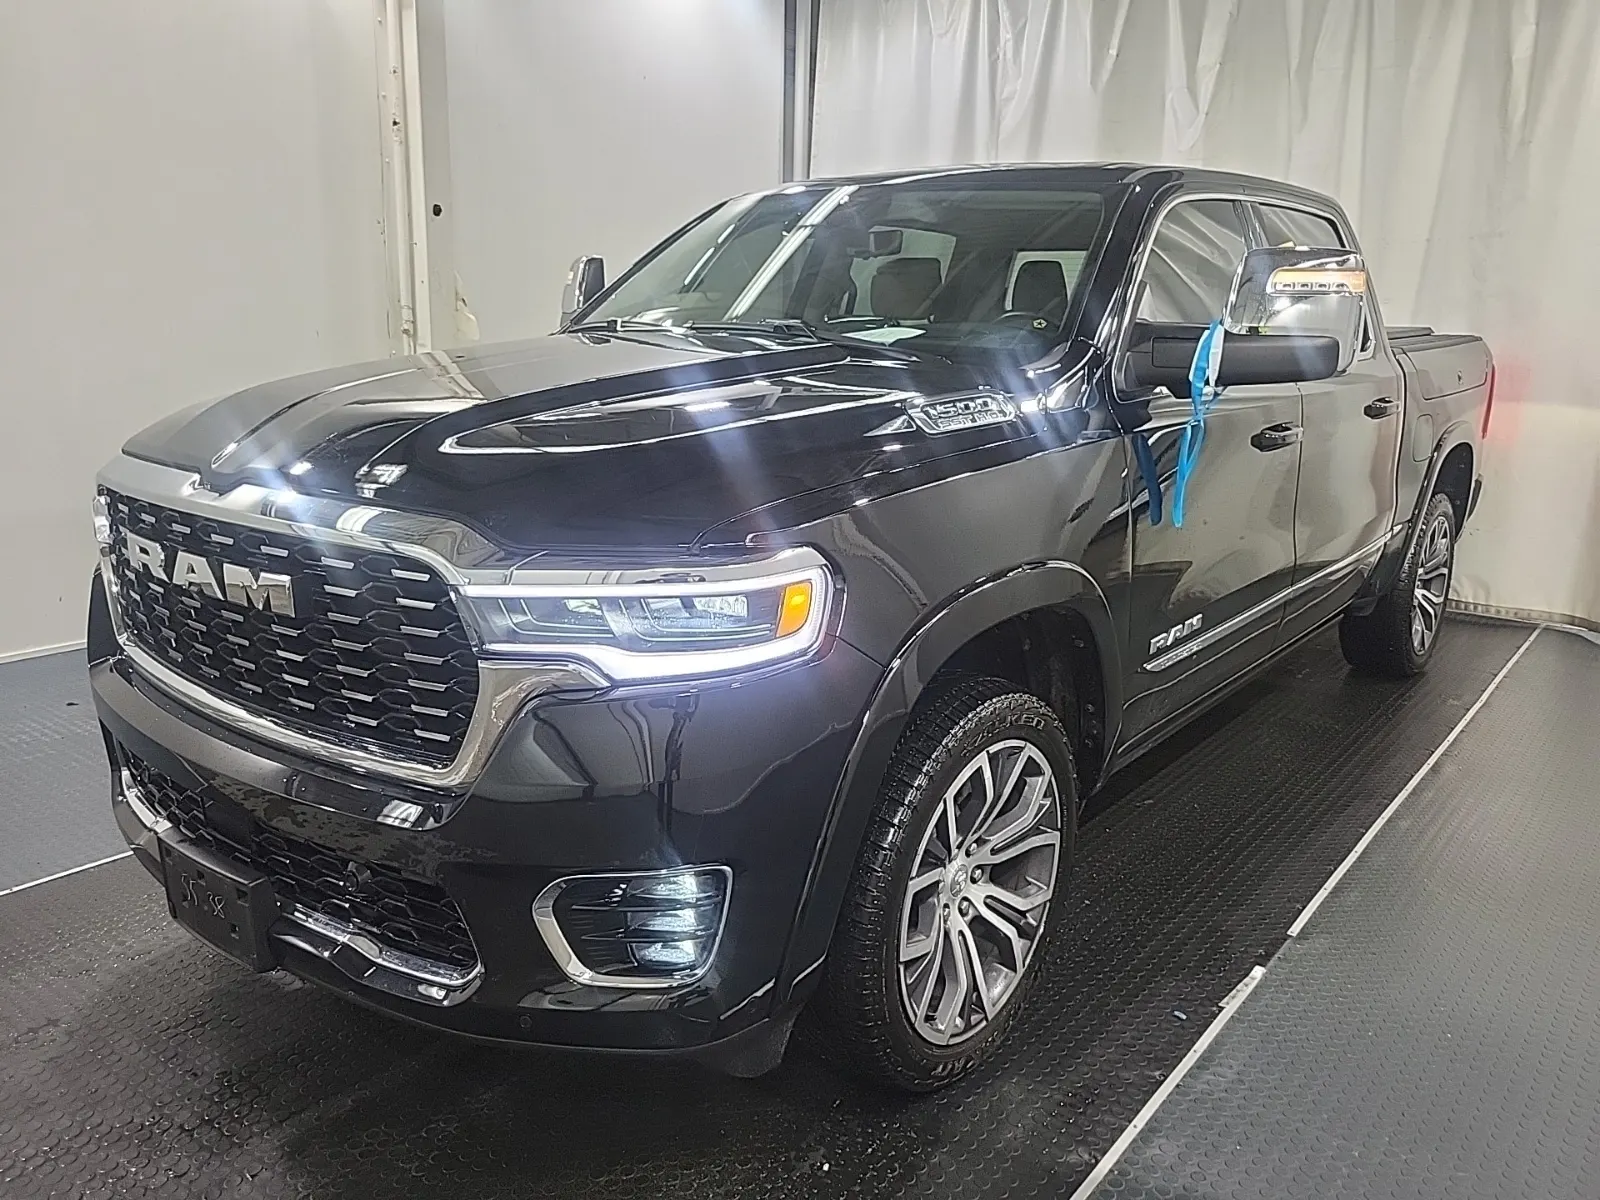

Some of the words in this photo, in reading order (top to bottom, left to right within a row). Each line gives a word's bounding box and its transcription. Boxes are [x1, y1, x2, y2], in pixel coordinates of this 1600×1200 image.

[923, 397, 993, 419] 1500
[938, 414, 973, 428] SST
[125, 529, 296, 619] RAM
[1148, 613, 1203, 655] RAM
